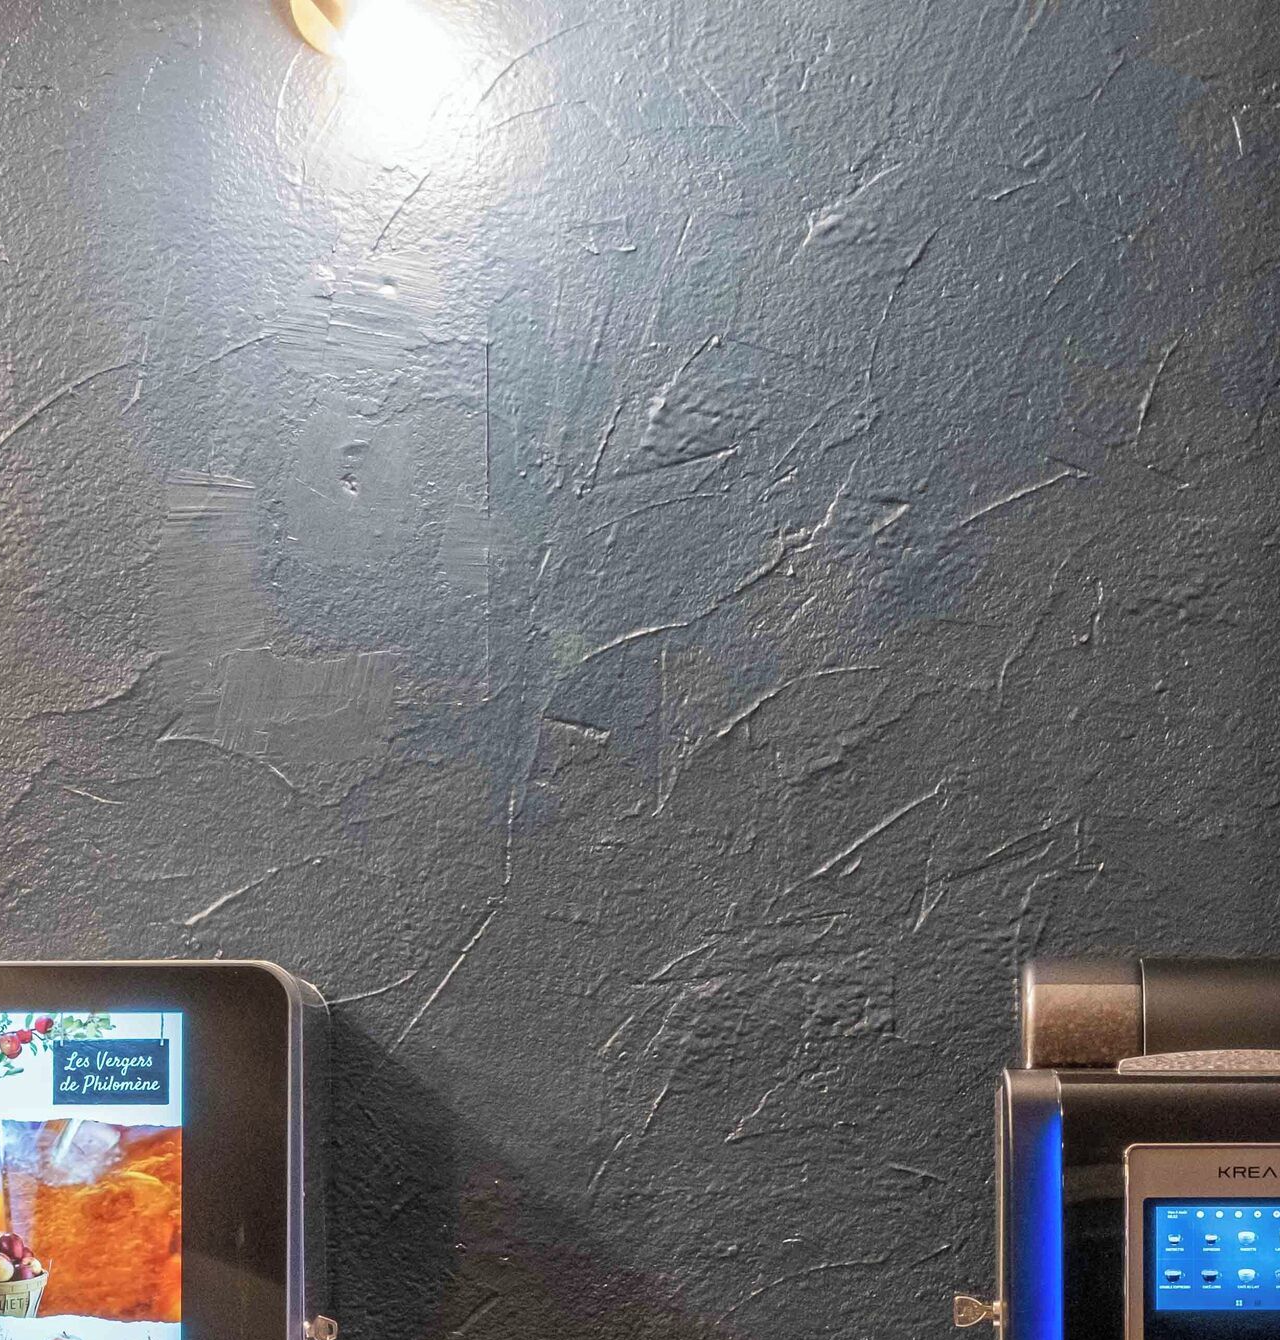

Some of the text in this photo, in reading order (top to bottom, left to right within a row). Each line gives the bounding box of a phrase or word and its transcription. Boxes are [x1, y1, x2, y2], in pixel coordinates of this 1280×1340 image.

[64, 1051, 153, 1075] Les Vergers
[60, 1075, 160, 1094] de Philomène
[1218, 1166, 1277, 1179] KREA
